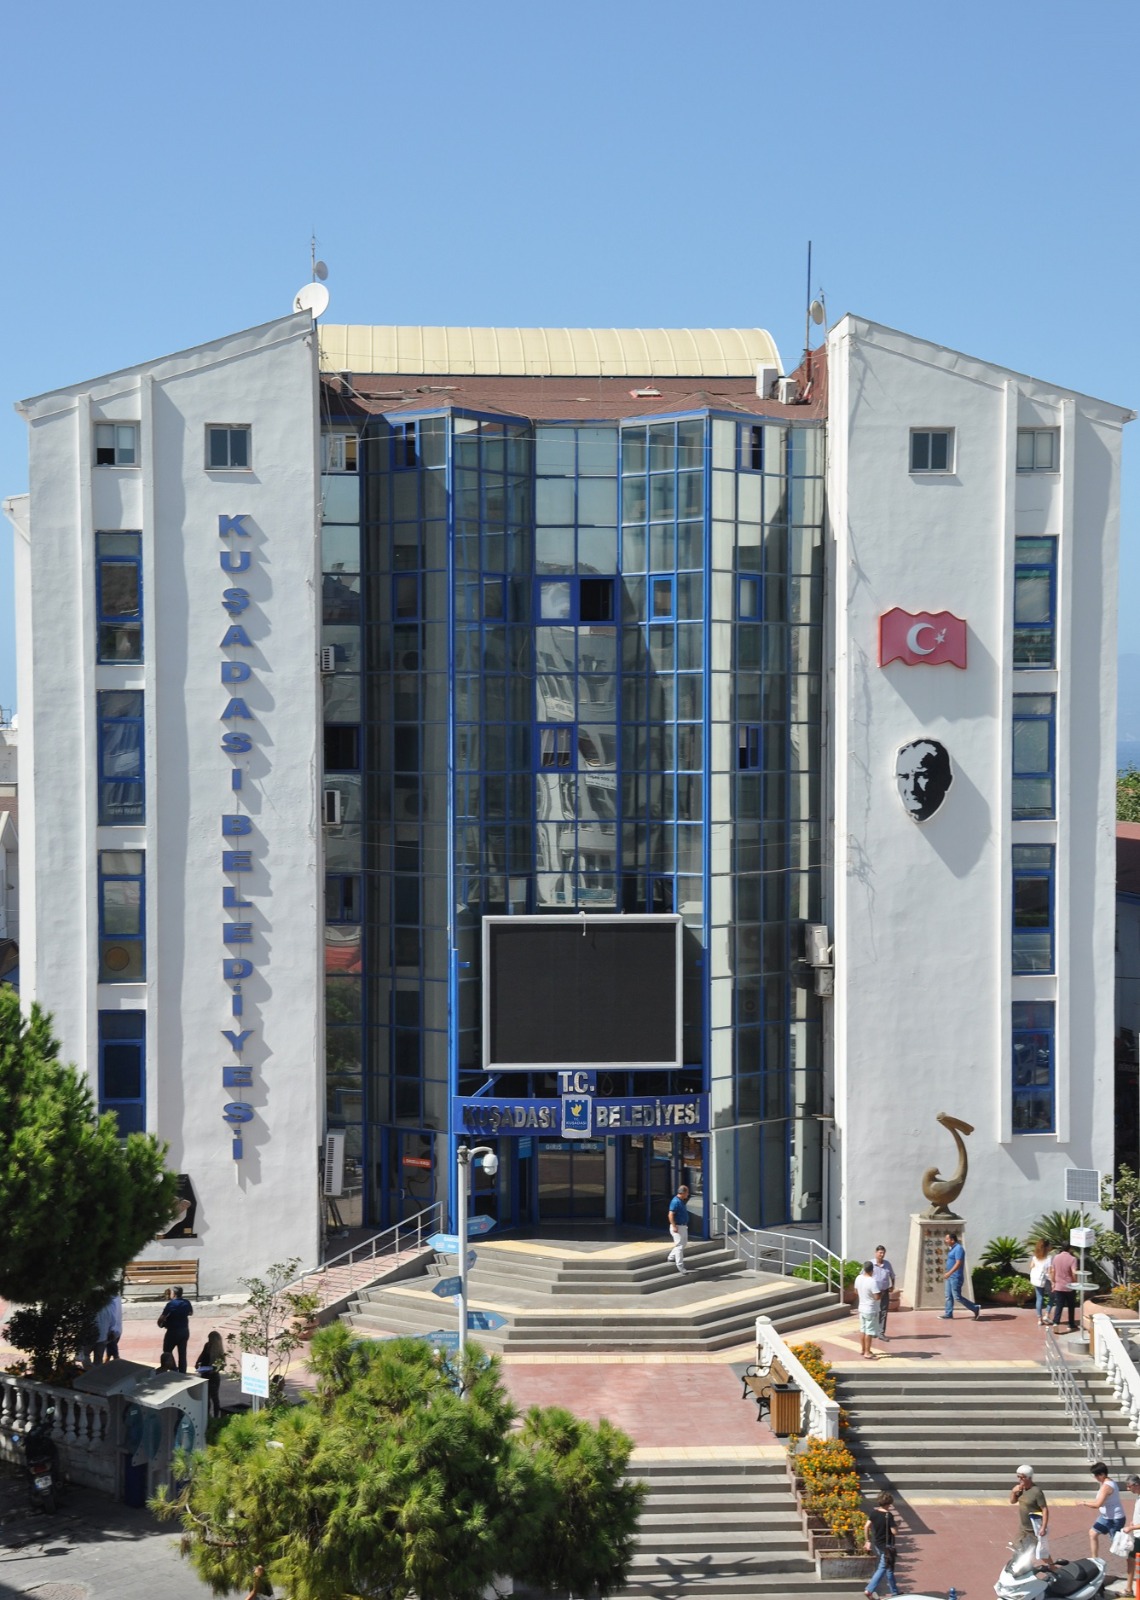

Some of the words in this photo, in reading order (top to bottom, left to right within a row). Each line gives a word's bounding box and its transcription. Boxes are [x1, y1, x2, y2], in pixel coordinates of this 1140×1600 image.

[218, 514, 255, 791] KUŞADASI
[220, 814, 255, 1161] BELEDİYESİ
[462, 1104, 557, 1132] KUŞADASI
[596, 1098, 700, 1128] BELEDİYESİ
[558, 1071, 595, 1093] T.C.
